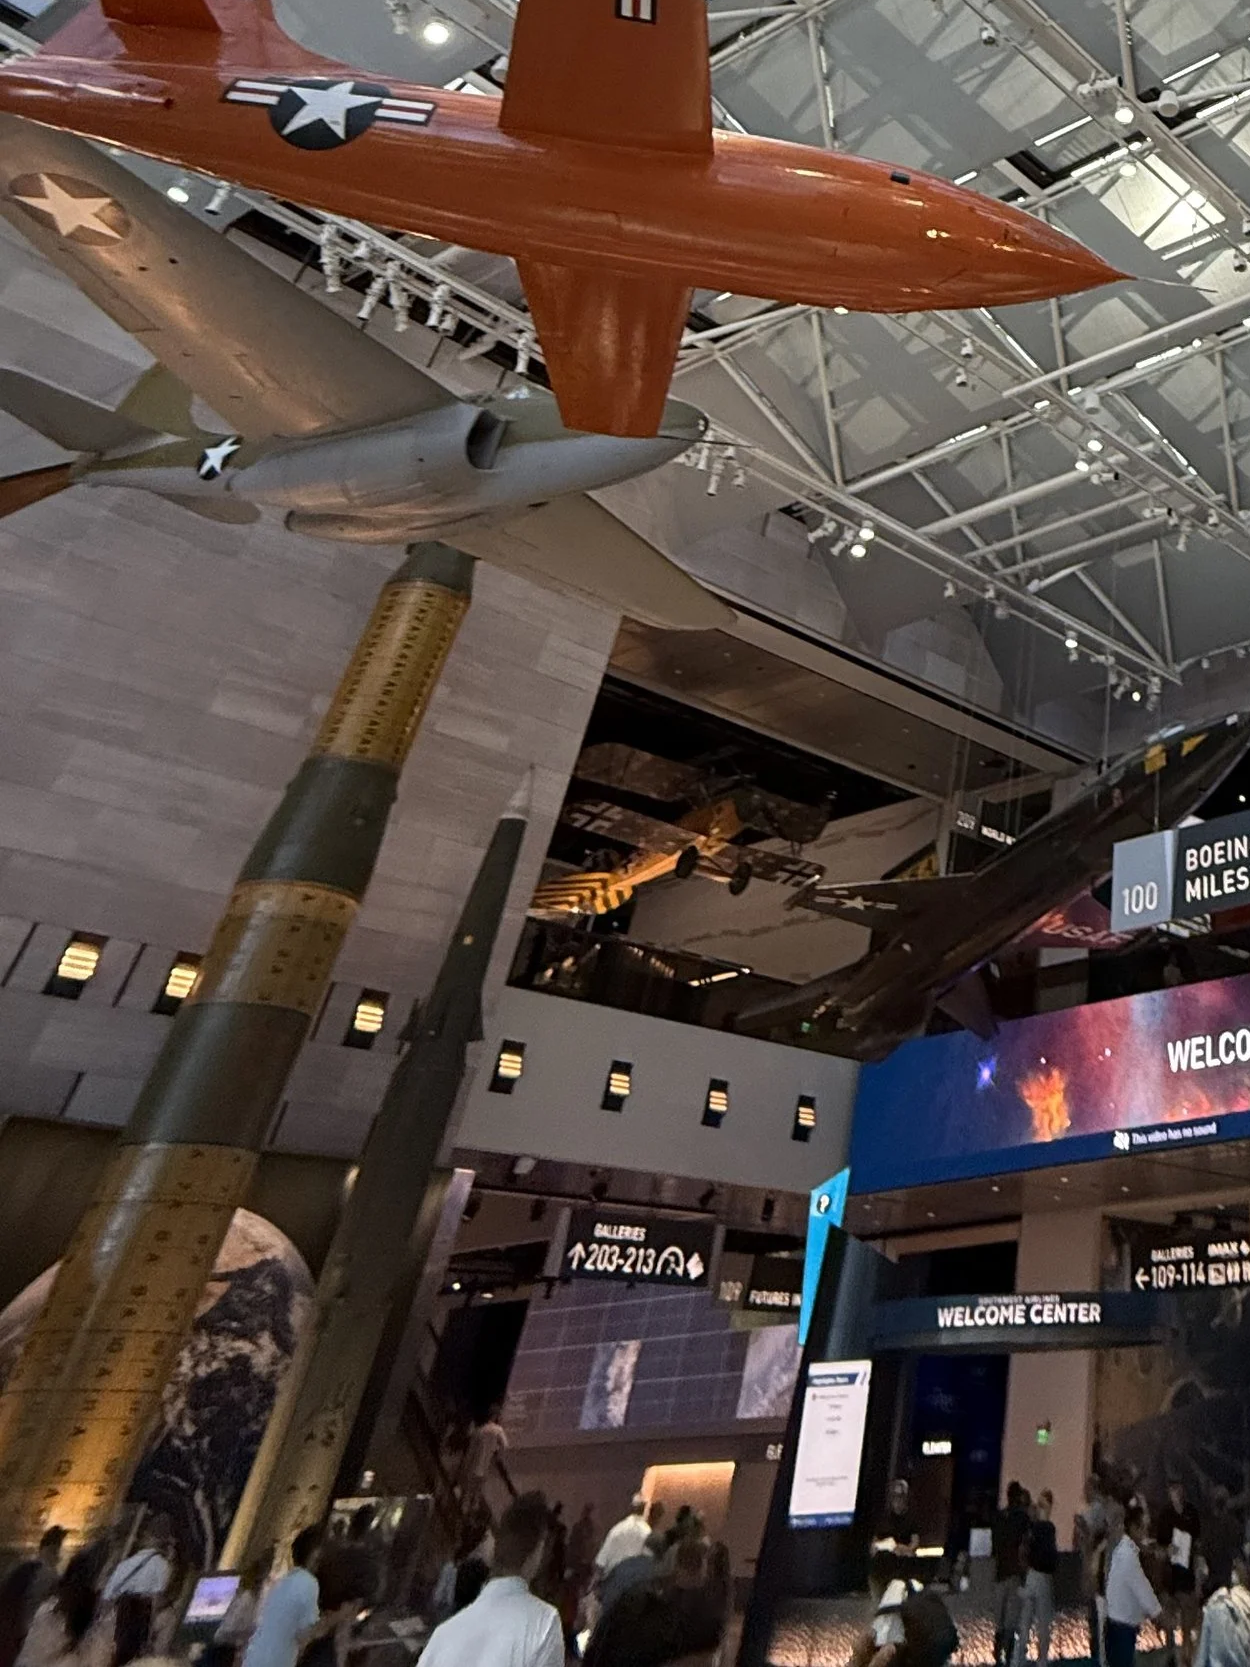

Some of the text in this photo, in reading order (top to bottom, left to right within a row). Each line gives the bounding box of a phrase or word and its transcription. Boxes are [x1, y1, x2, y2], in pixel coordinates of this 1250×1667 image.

[1121, 881, 1158, 916] 100
[594, 1223, 647, 1242] GALLERIES
[584, 1243, 656, 1276] 203-213
[1151, 1245, 1195, 1263] GALLERIES
[1150, 1261, 1206, 1289] 109-114
[937, 1302, 1102, 1328] WELCOME CENTER
